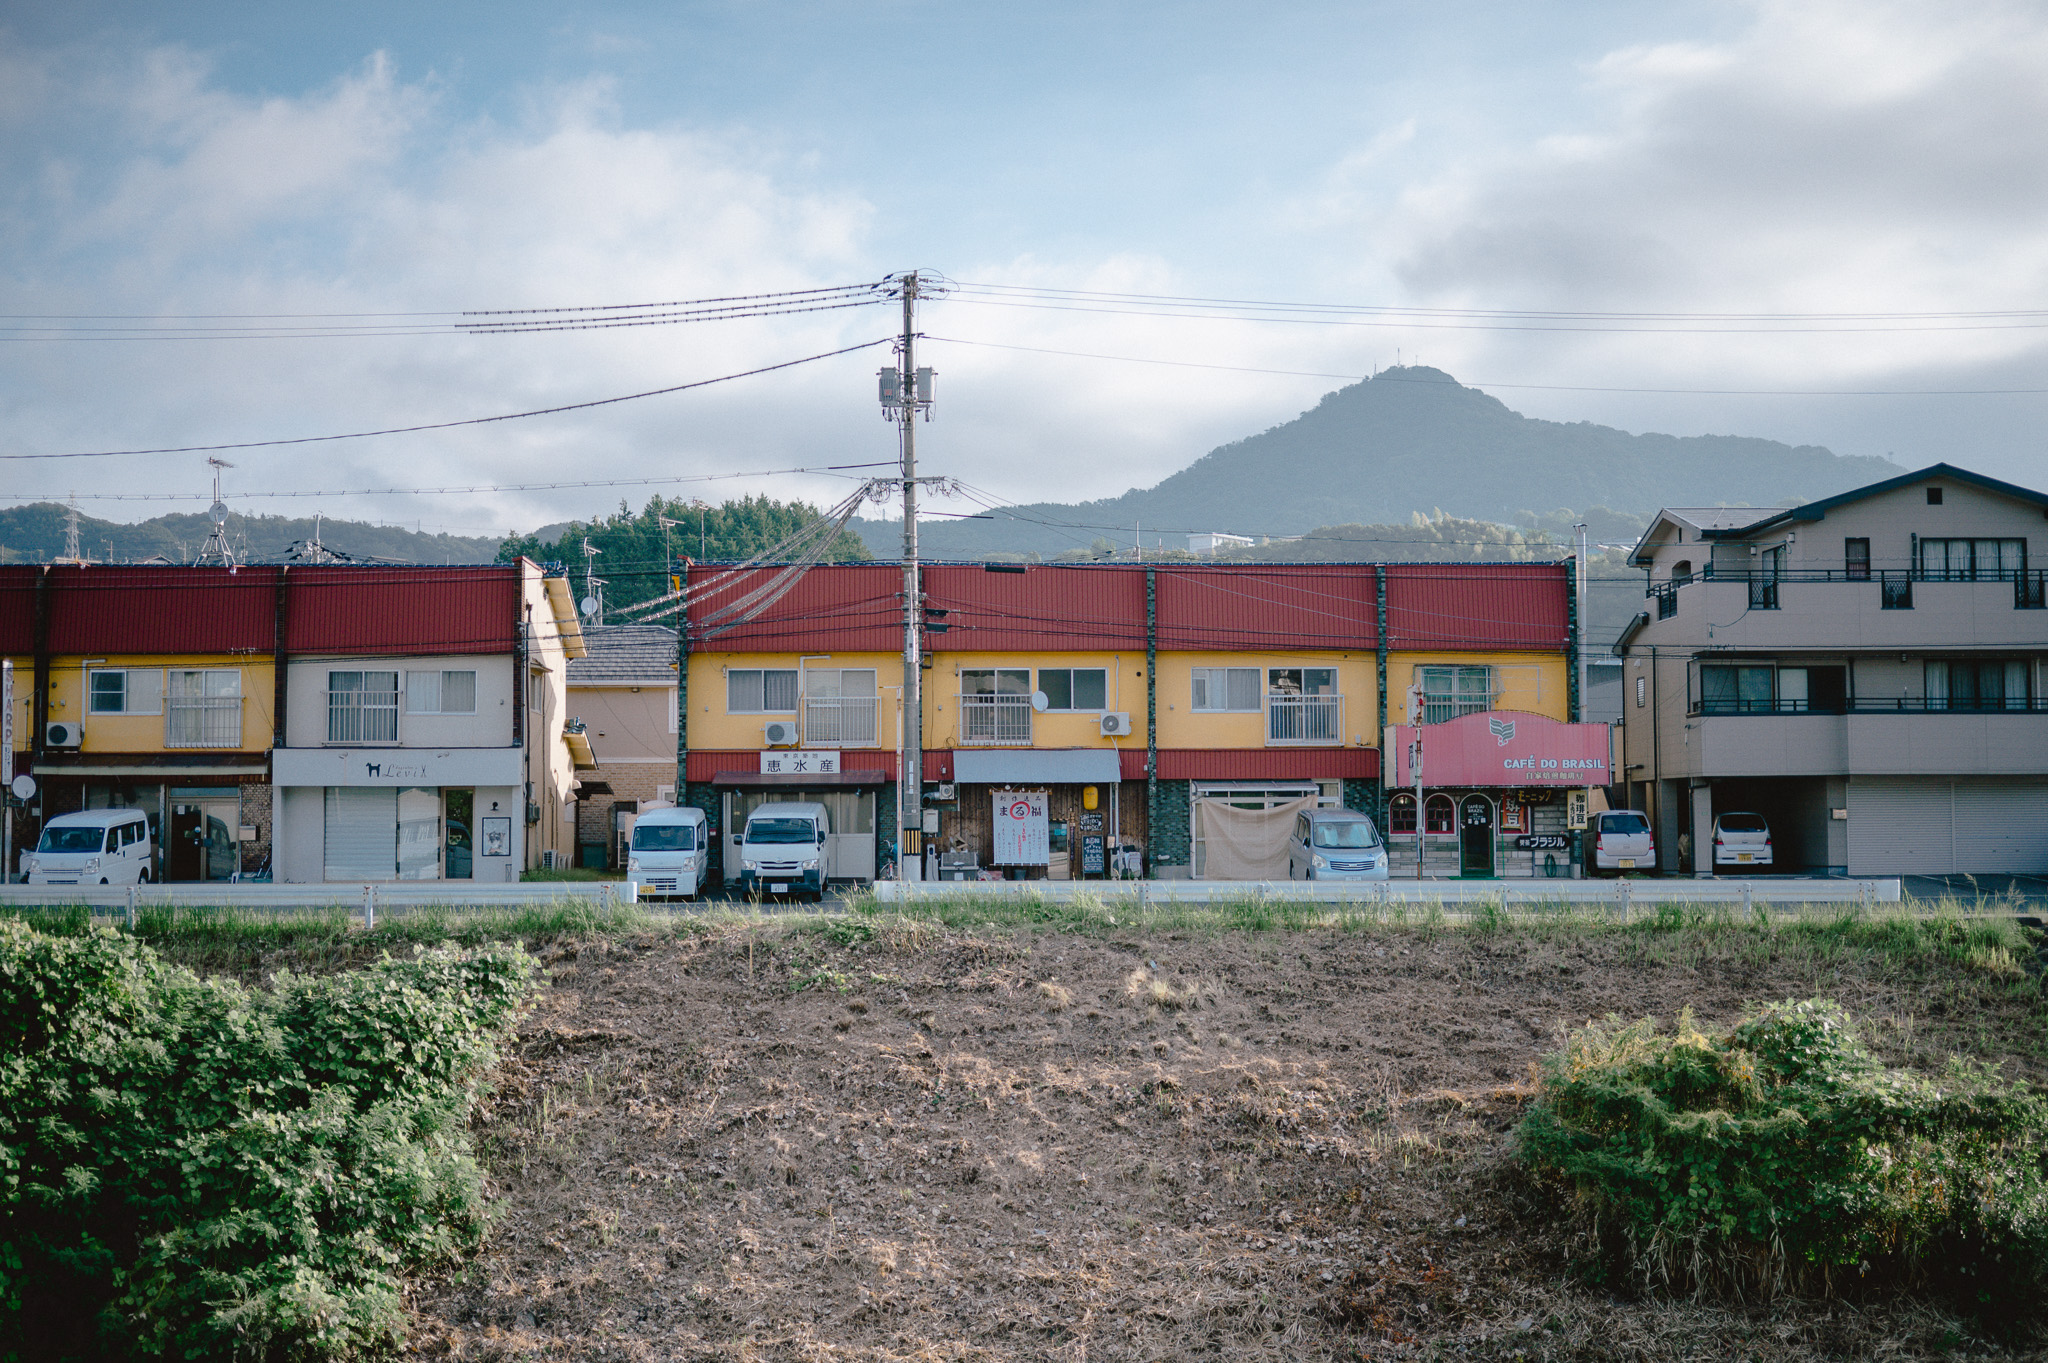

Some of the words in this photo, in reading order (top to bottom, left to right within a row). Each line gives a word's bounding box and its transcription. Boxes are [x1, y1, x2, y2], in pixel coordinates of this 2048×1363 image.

[5, 668, 13, 742] SHARP
[767, 760, 834, 773] 恵水産
[1504, 755, 1536, 769] CAFÉ
[1541, 759, 1558, 769] DO
[1562, 759, 1606, 769] BRASIL
[1000, 805, 1042, 817] まる福
[1576, 794, 1585, 824] 珈琲豆
